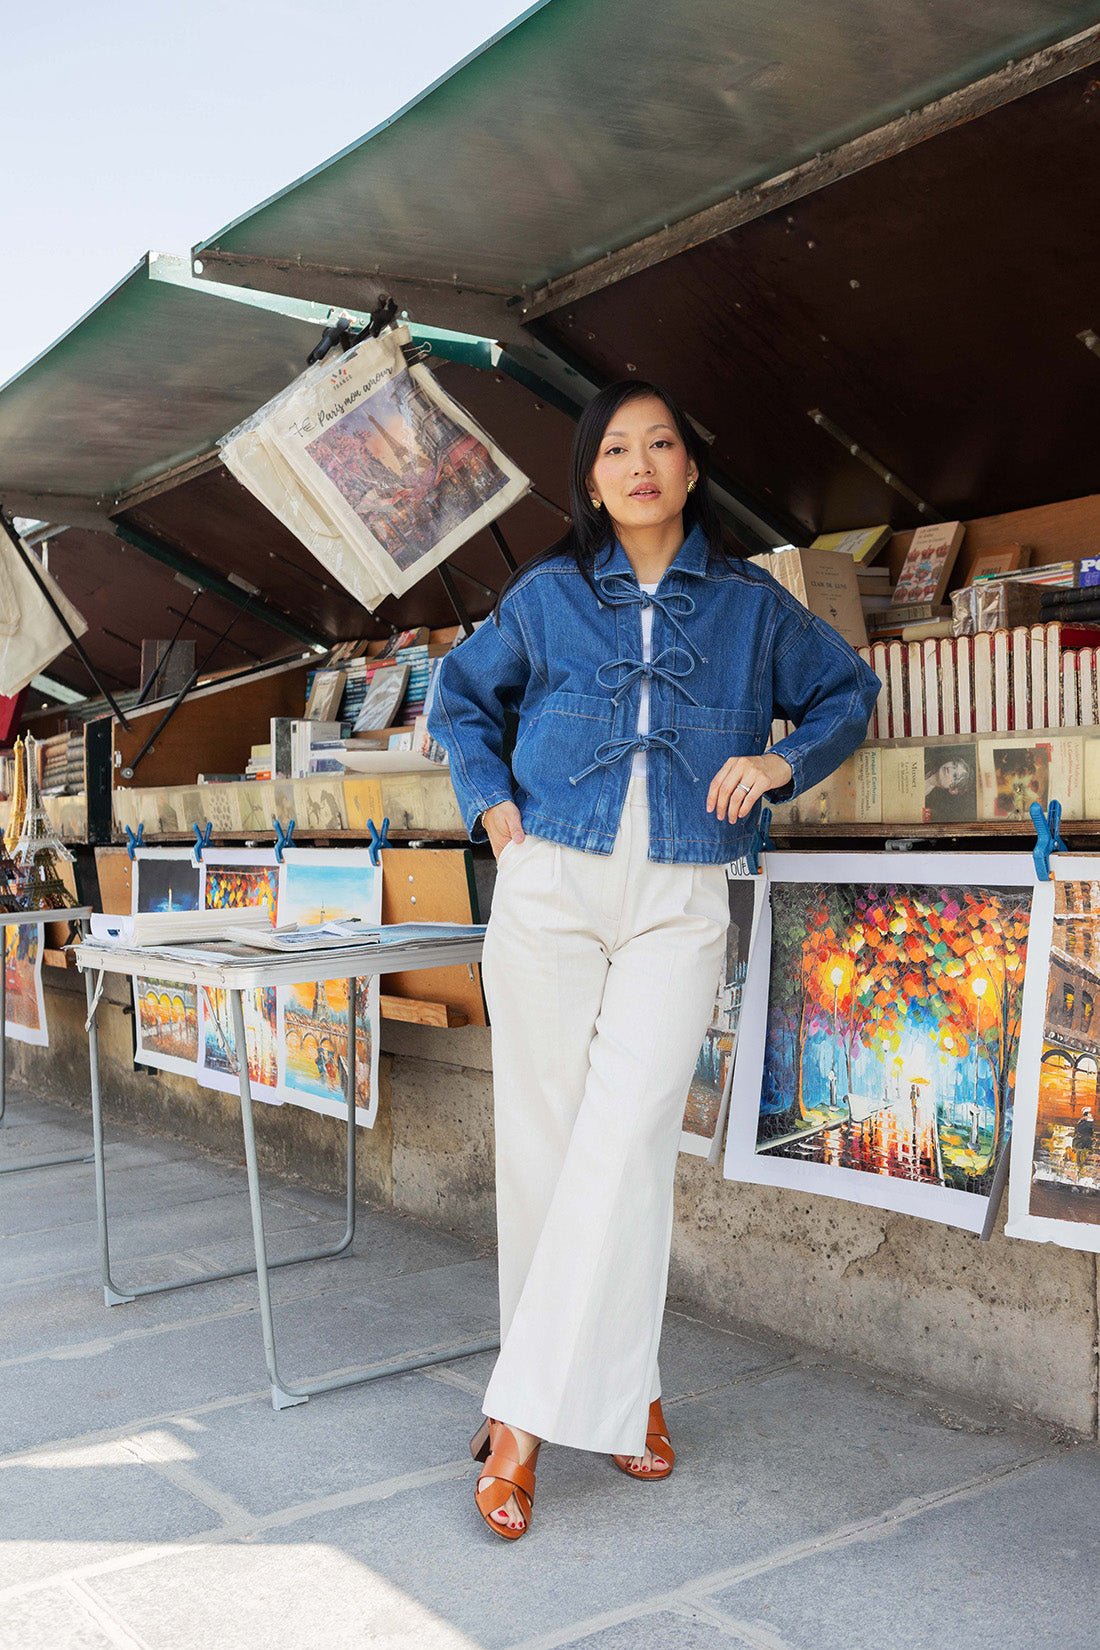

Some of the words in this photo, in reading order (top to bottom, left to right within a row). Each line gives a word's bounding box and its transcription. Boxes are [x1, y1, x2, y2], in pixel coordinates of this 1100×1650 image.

[317, 404, 345, 427] Paris
[344, 389, 362, 406] mon
[362, 367, 393, 393] amour
